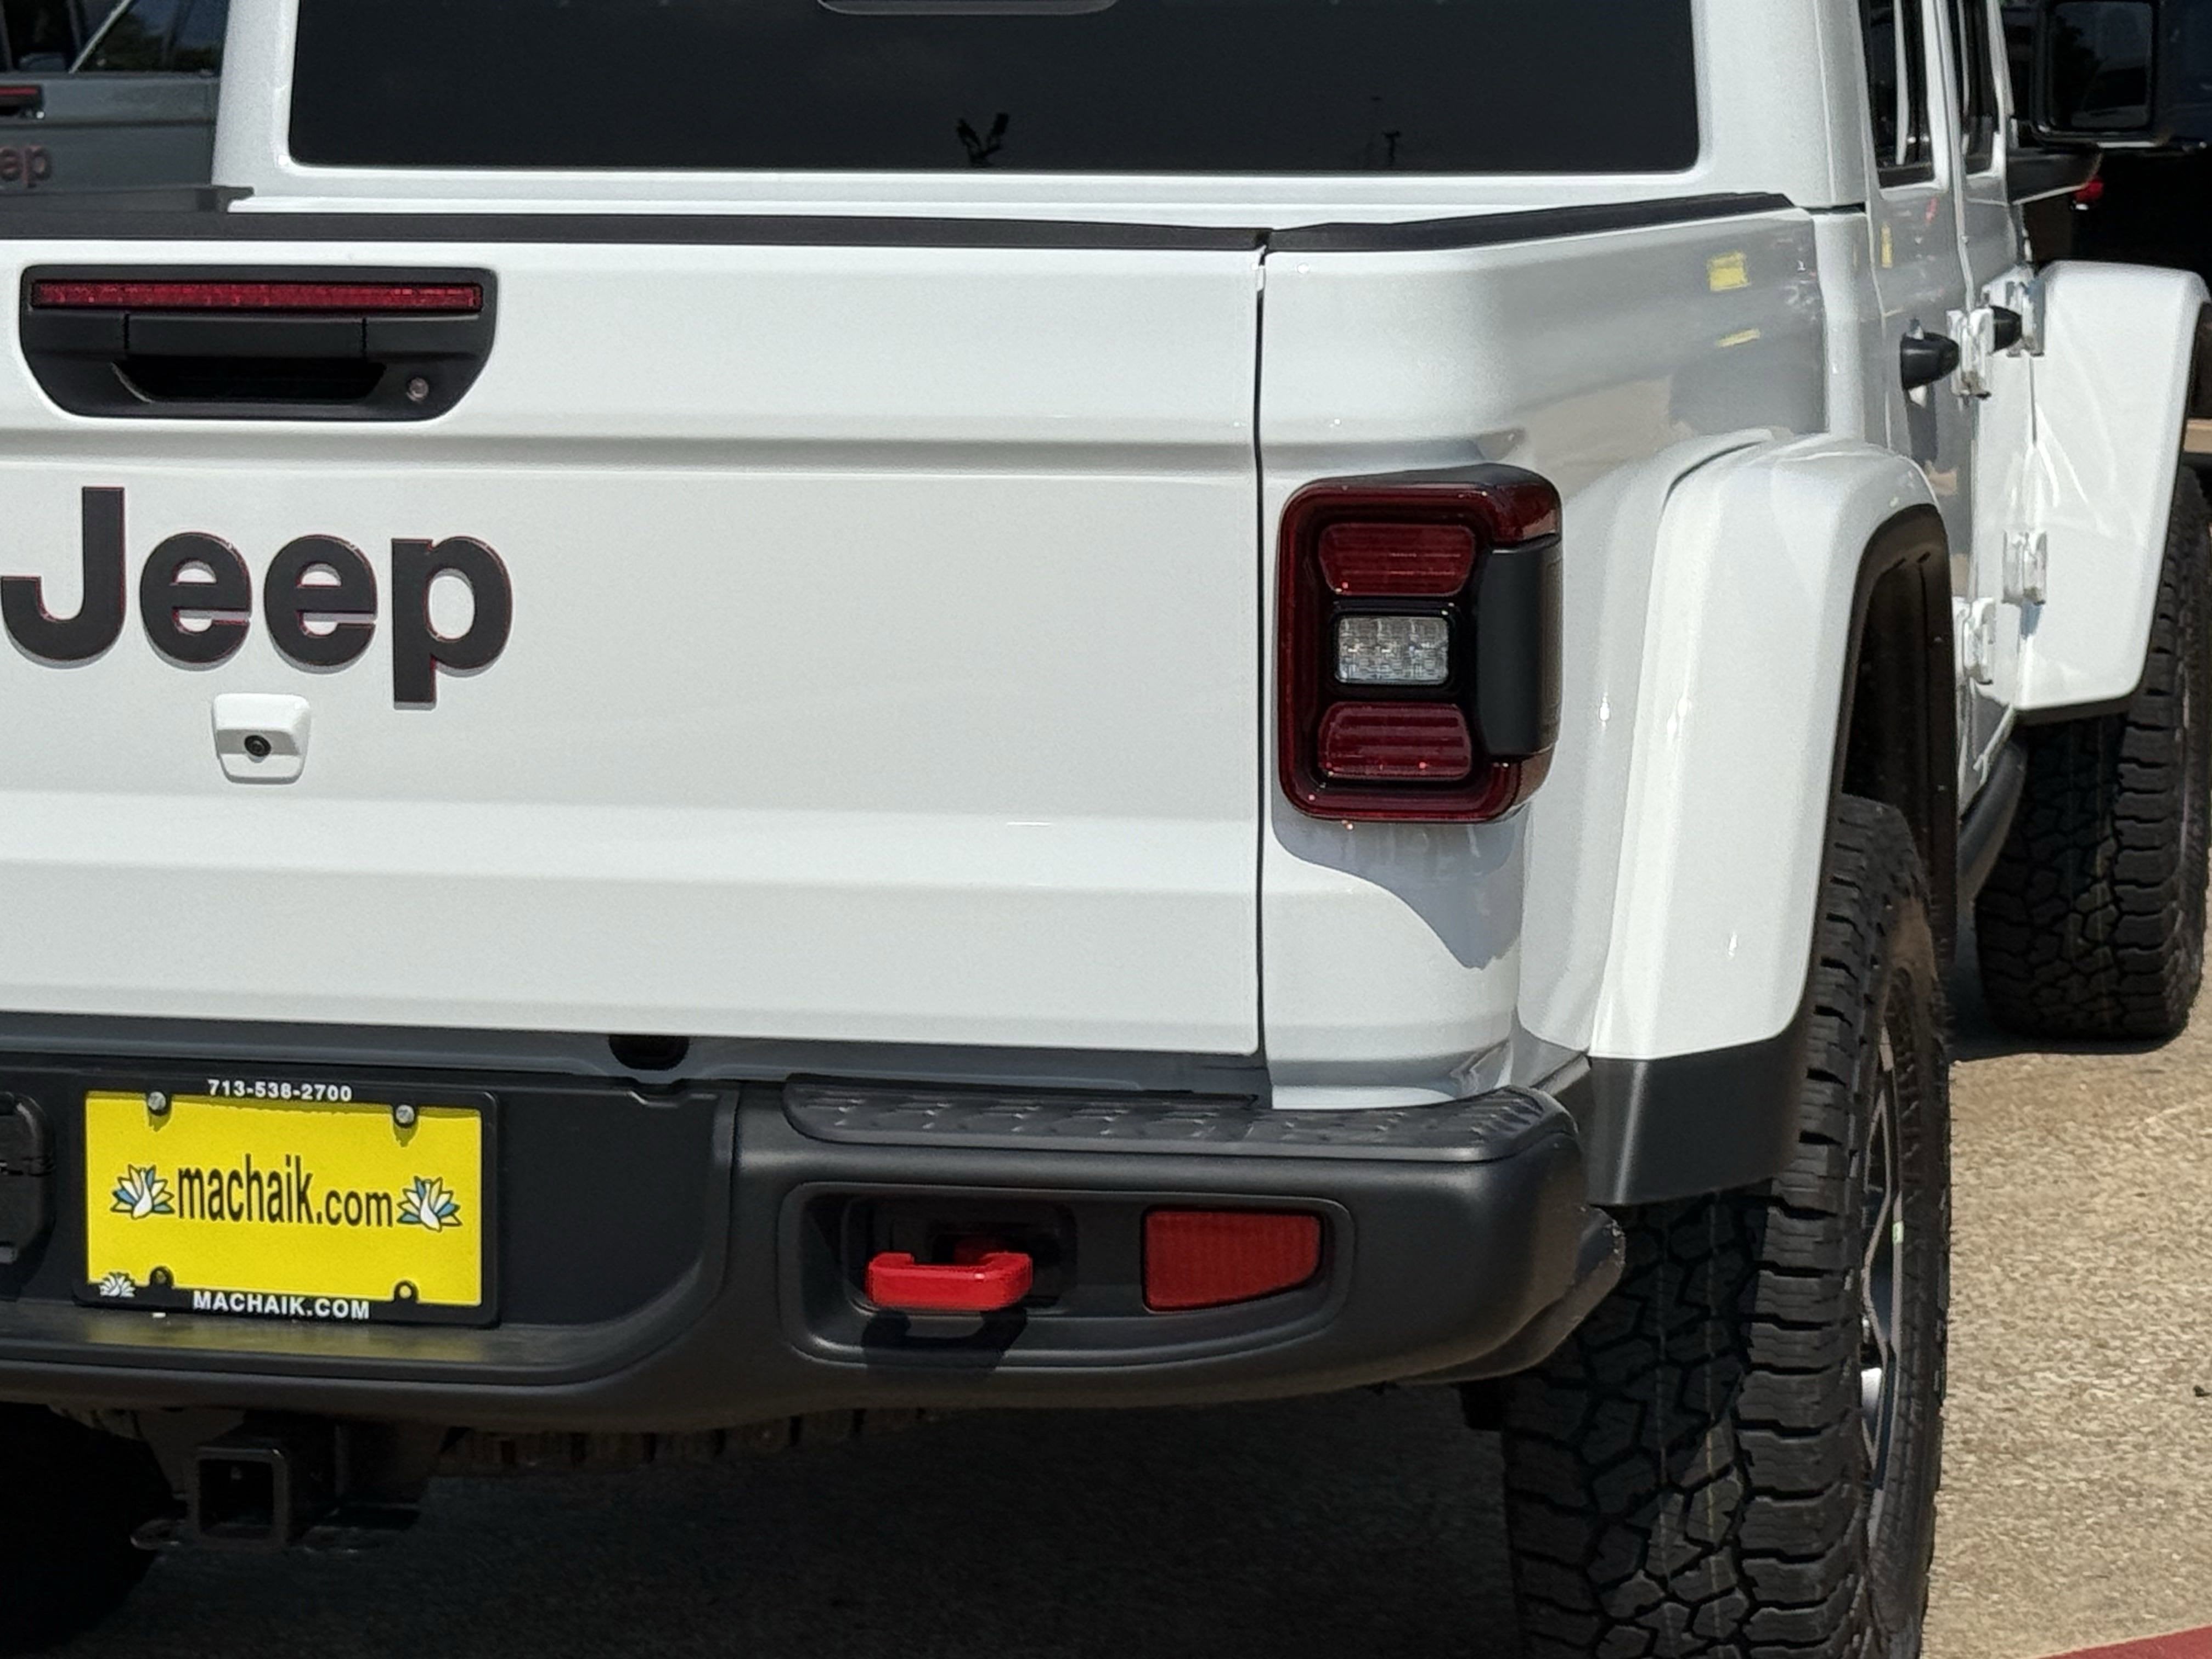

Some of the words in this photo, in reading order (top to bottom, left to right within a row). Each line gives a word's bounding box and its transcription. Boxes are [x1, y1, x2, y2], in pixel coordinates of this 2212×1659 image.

[0, 486, 513, 710] Jeep
[208, 1079, 352, 1101] 713-538-2700
[177, 1153, 393, 1227] machaik.com
[193, 1291, 370, 1319] MACHAIK.COM
